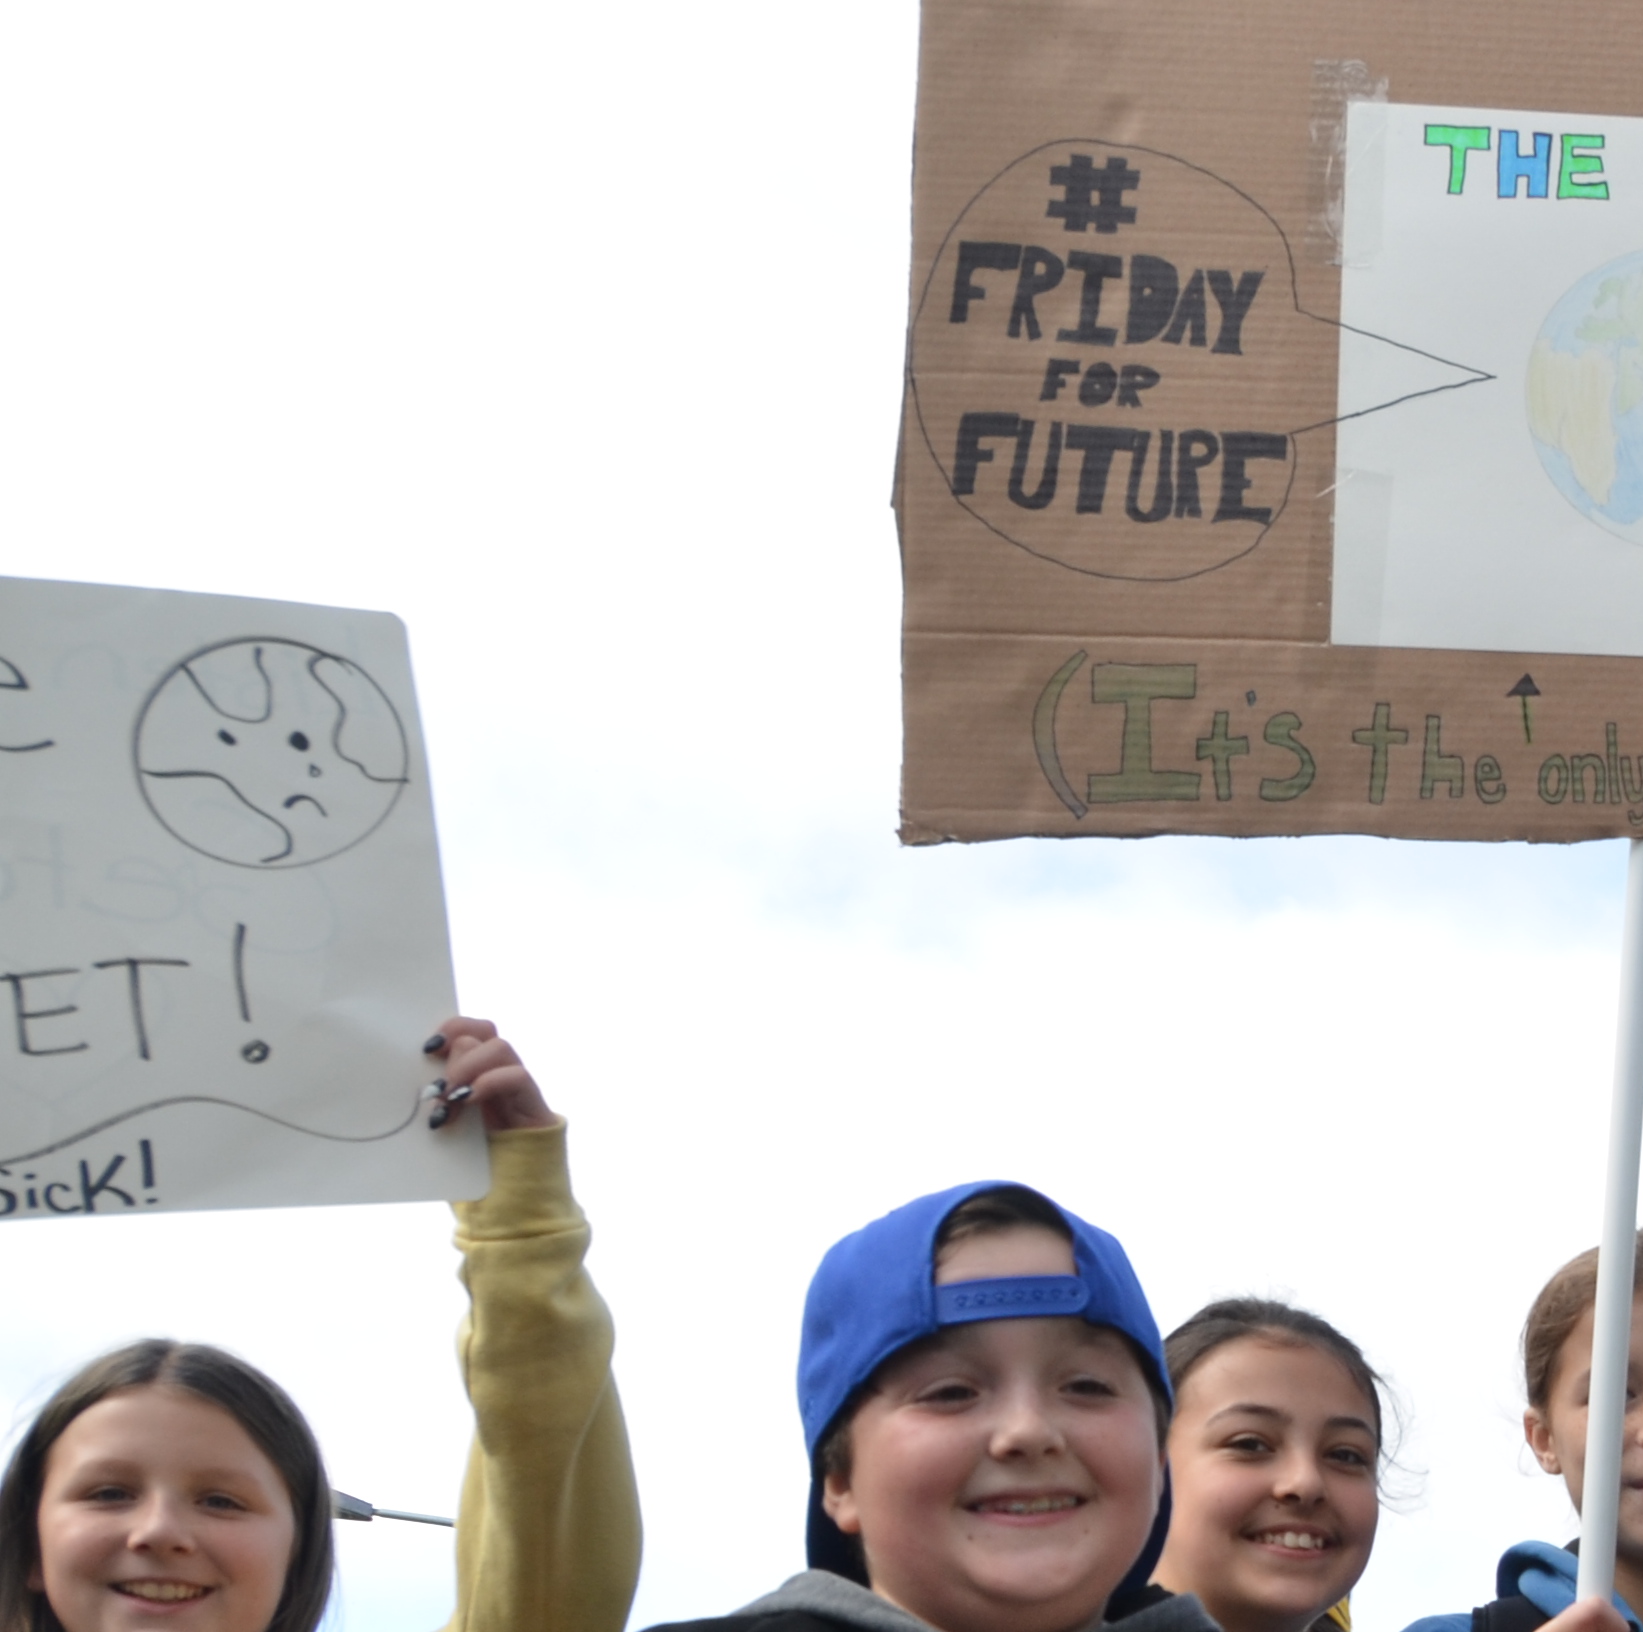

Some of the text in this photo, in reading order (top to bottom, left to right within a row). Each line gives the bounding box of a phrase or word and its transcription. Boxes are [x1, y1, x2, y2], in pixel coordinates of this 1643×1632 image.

[1424, 123, 1611, 201] THE
[948, 240, 1269, 356] FRIDAY
[1039, 358, 1161, 409] FOR
[951, 412, 1288, 526] FUTURE
[1351, 702, 1507, 804] the
